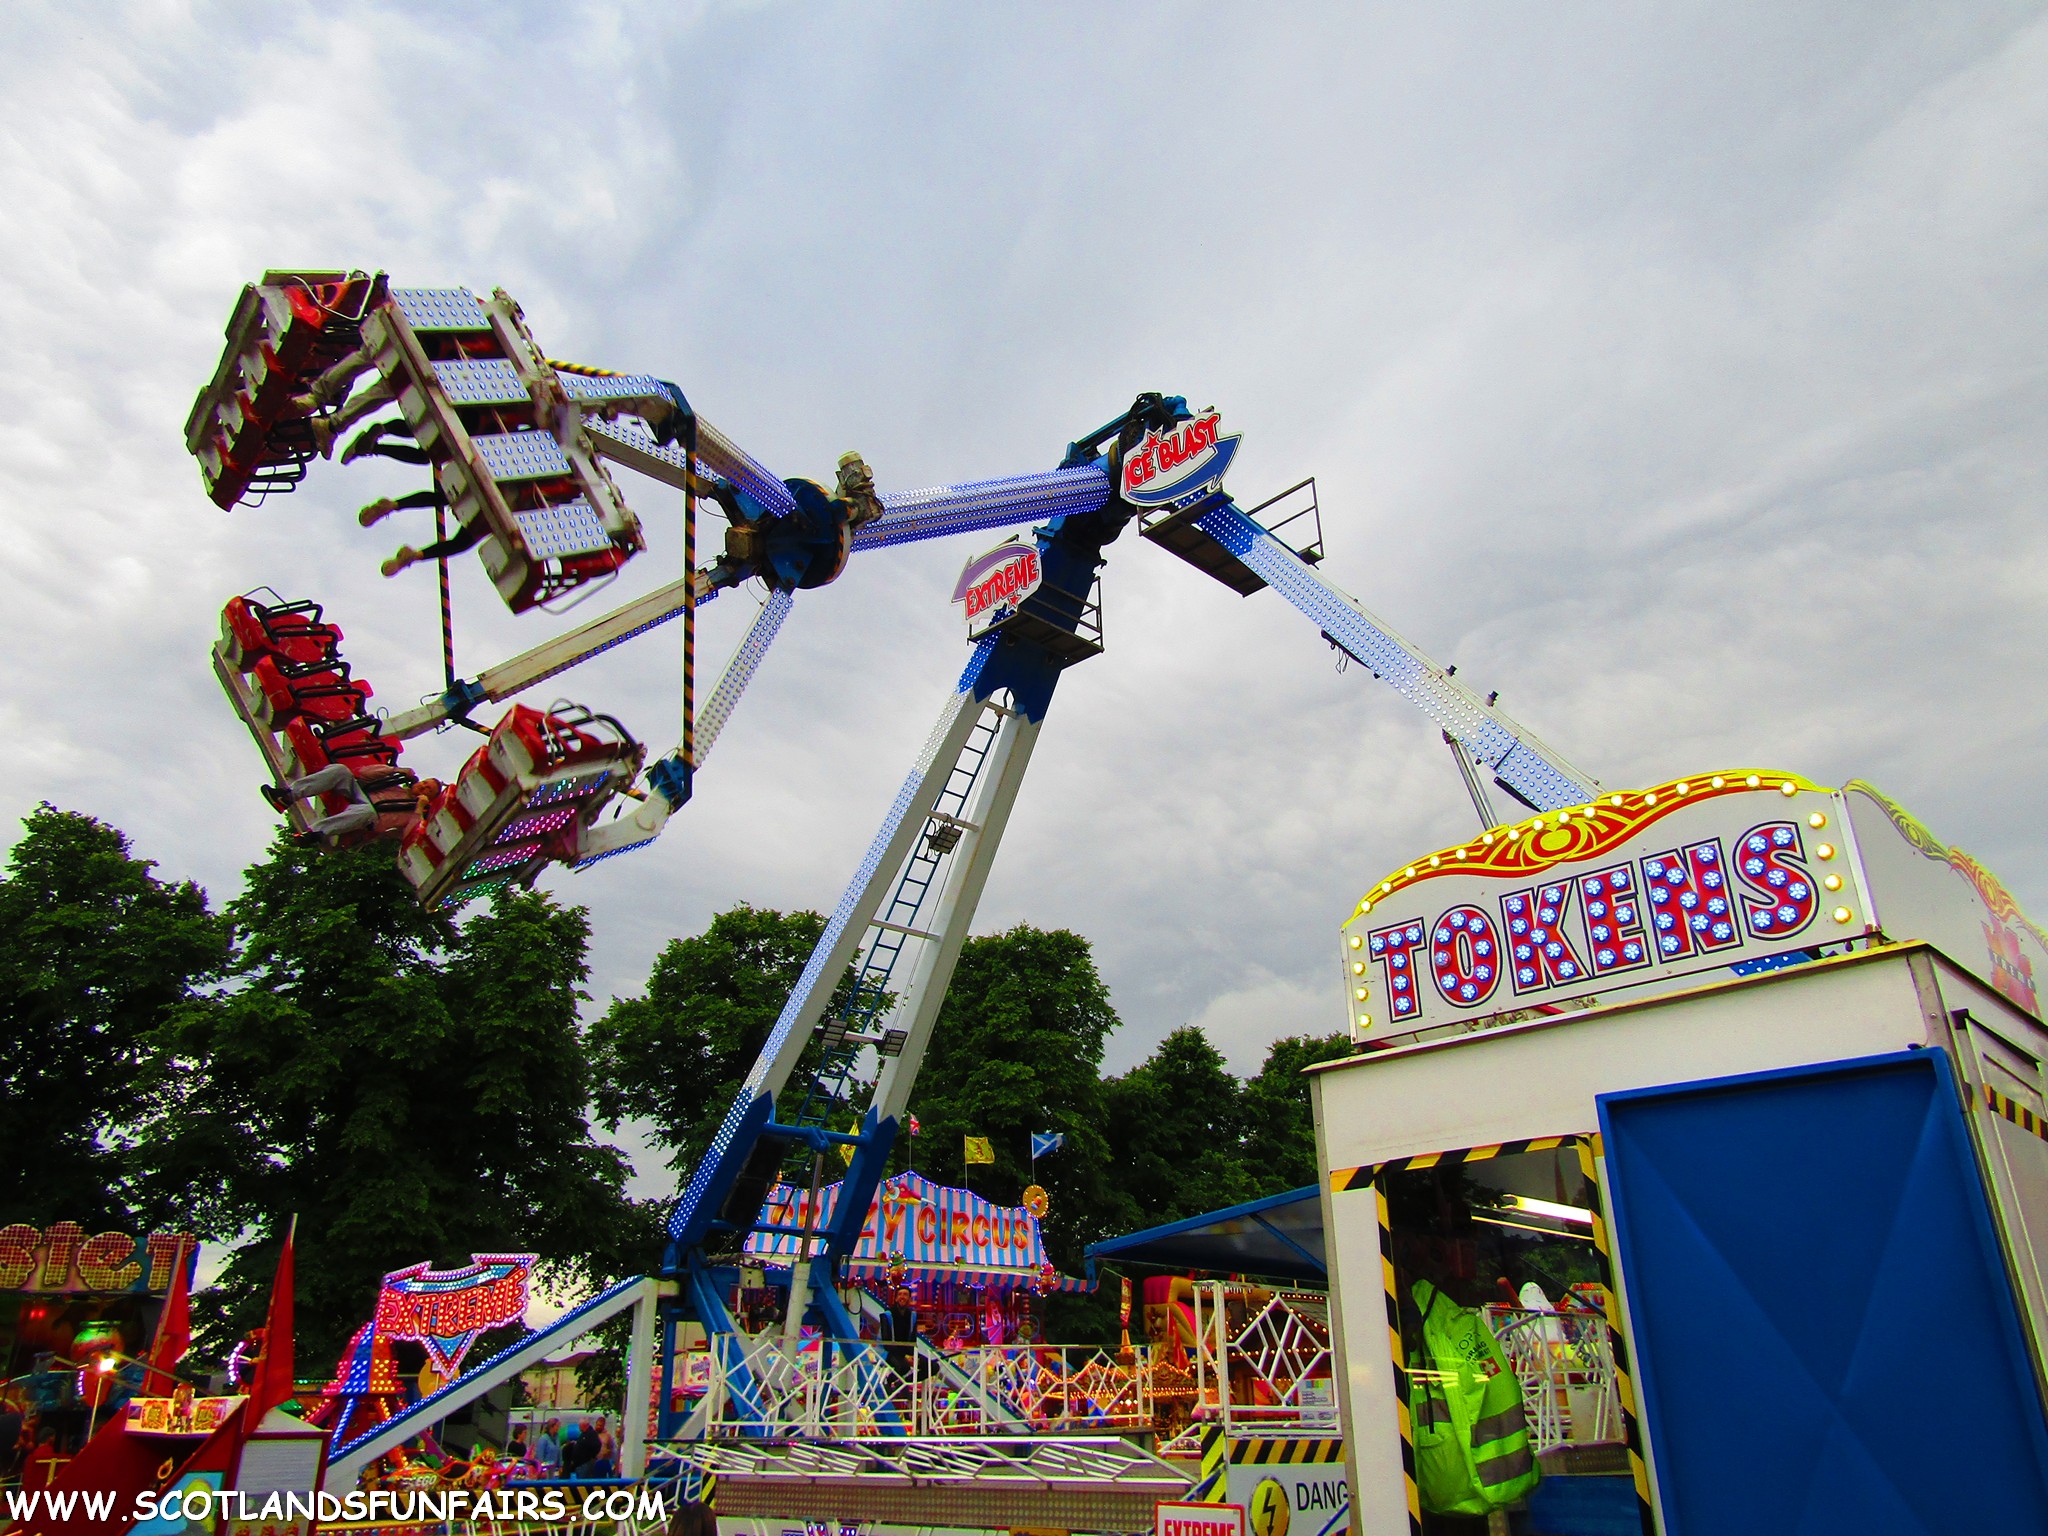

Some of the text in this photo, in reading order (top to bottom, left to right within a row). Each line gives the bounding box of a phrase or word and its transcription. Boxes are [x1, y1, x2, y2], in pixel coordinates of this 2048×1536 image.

[1124, 414, 1220, 493] ICE BLAST
[965, 552, 1038, 618] EXTREME
[1367, 821, 1820, 1023] TOKENS
[770, 1200, 1029, 1250] CRZY CIRCUS
[380, 1268, 527, 1336] EXTREME
